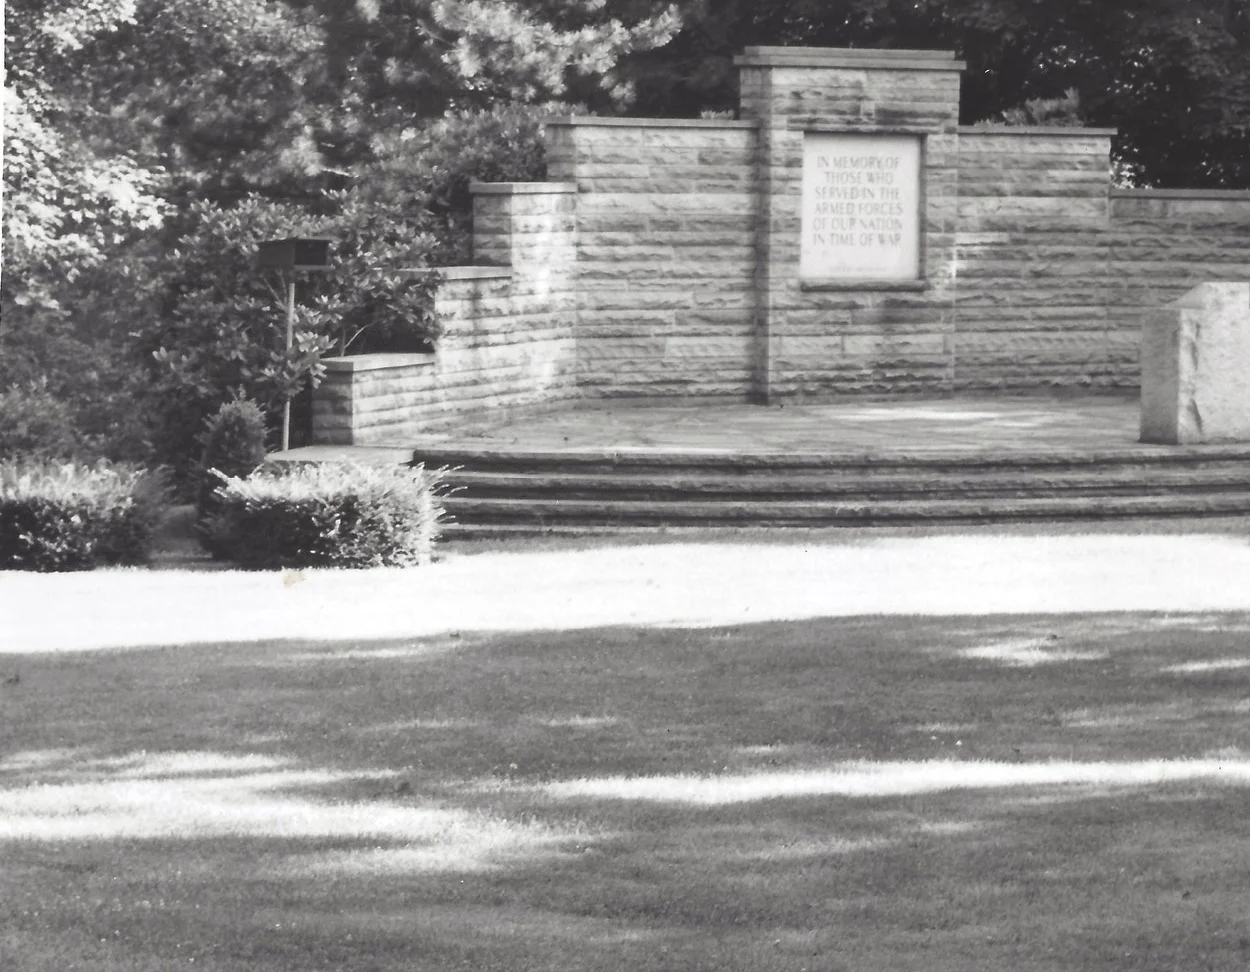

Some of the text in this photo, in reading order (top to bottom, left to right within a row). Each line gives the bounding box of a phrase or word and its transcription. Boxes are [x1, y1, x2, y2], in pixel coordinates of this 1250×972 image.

[817, 155, 901, 169] IN MEMORY OF
[824, 171, 894, 185] THOSE WHO
[815, 186, 900, 200] SERVED IN THE
[815, 202, 904, 216] ARMED FORCES
[812, 217, 903, 231] OF OUR NATION
[813, 233, 901, 246] IN TIME OF WAR
